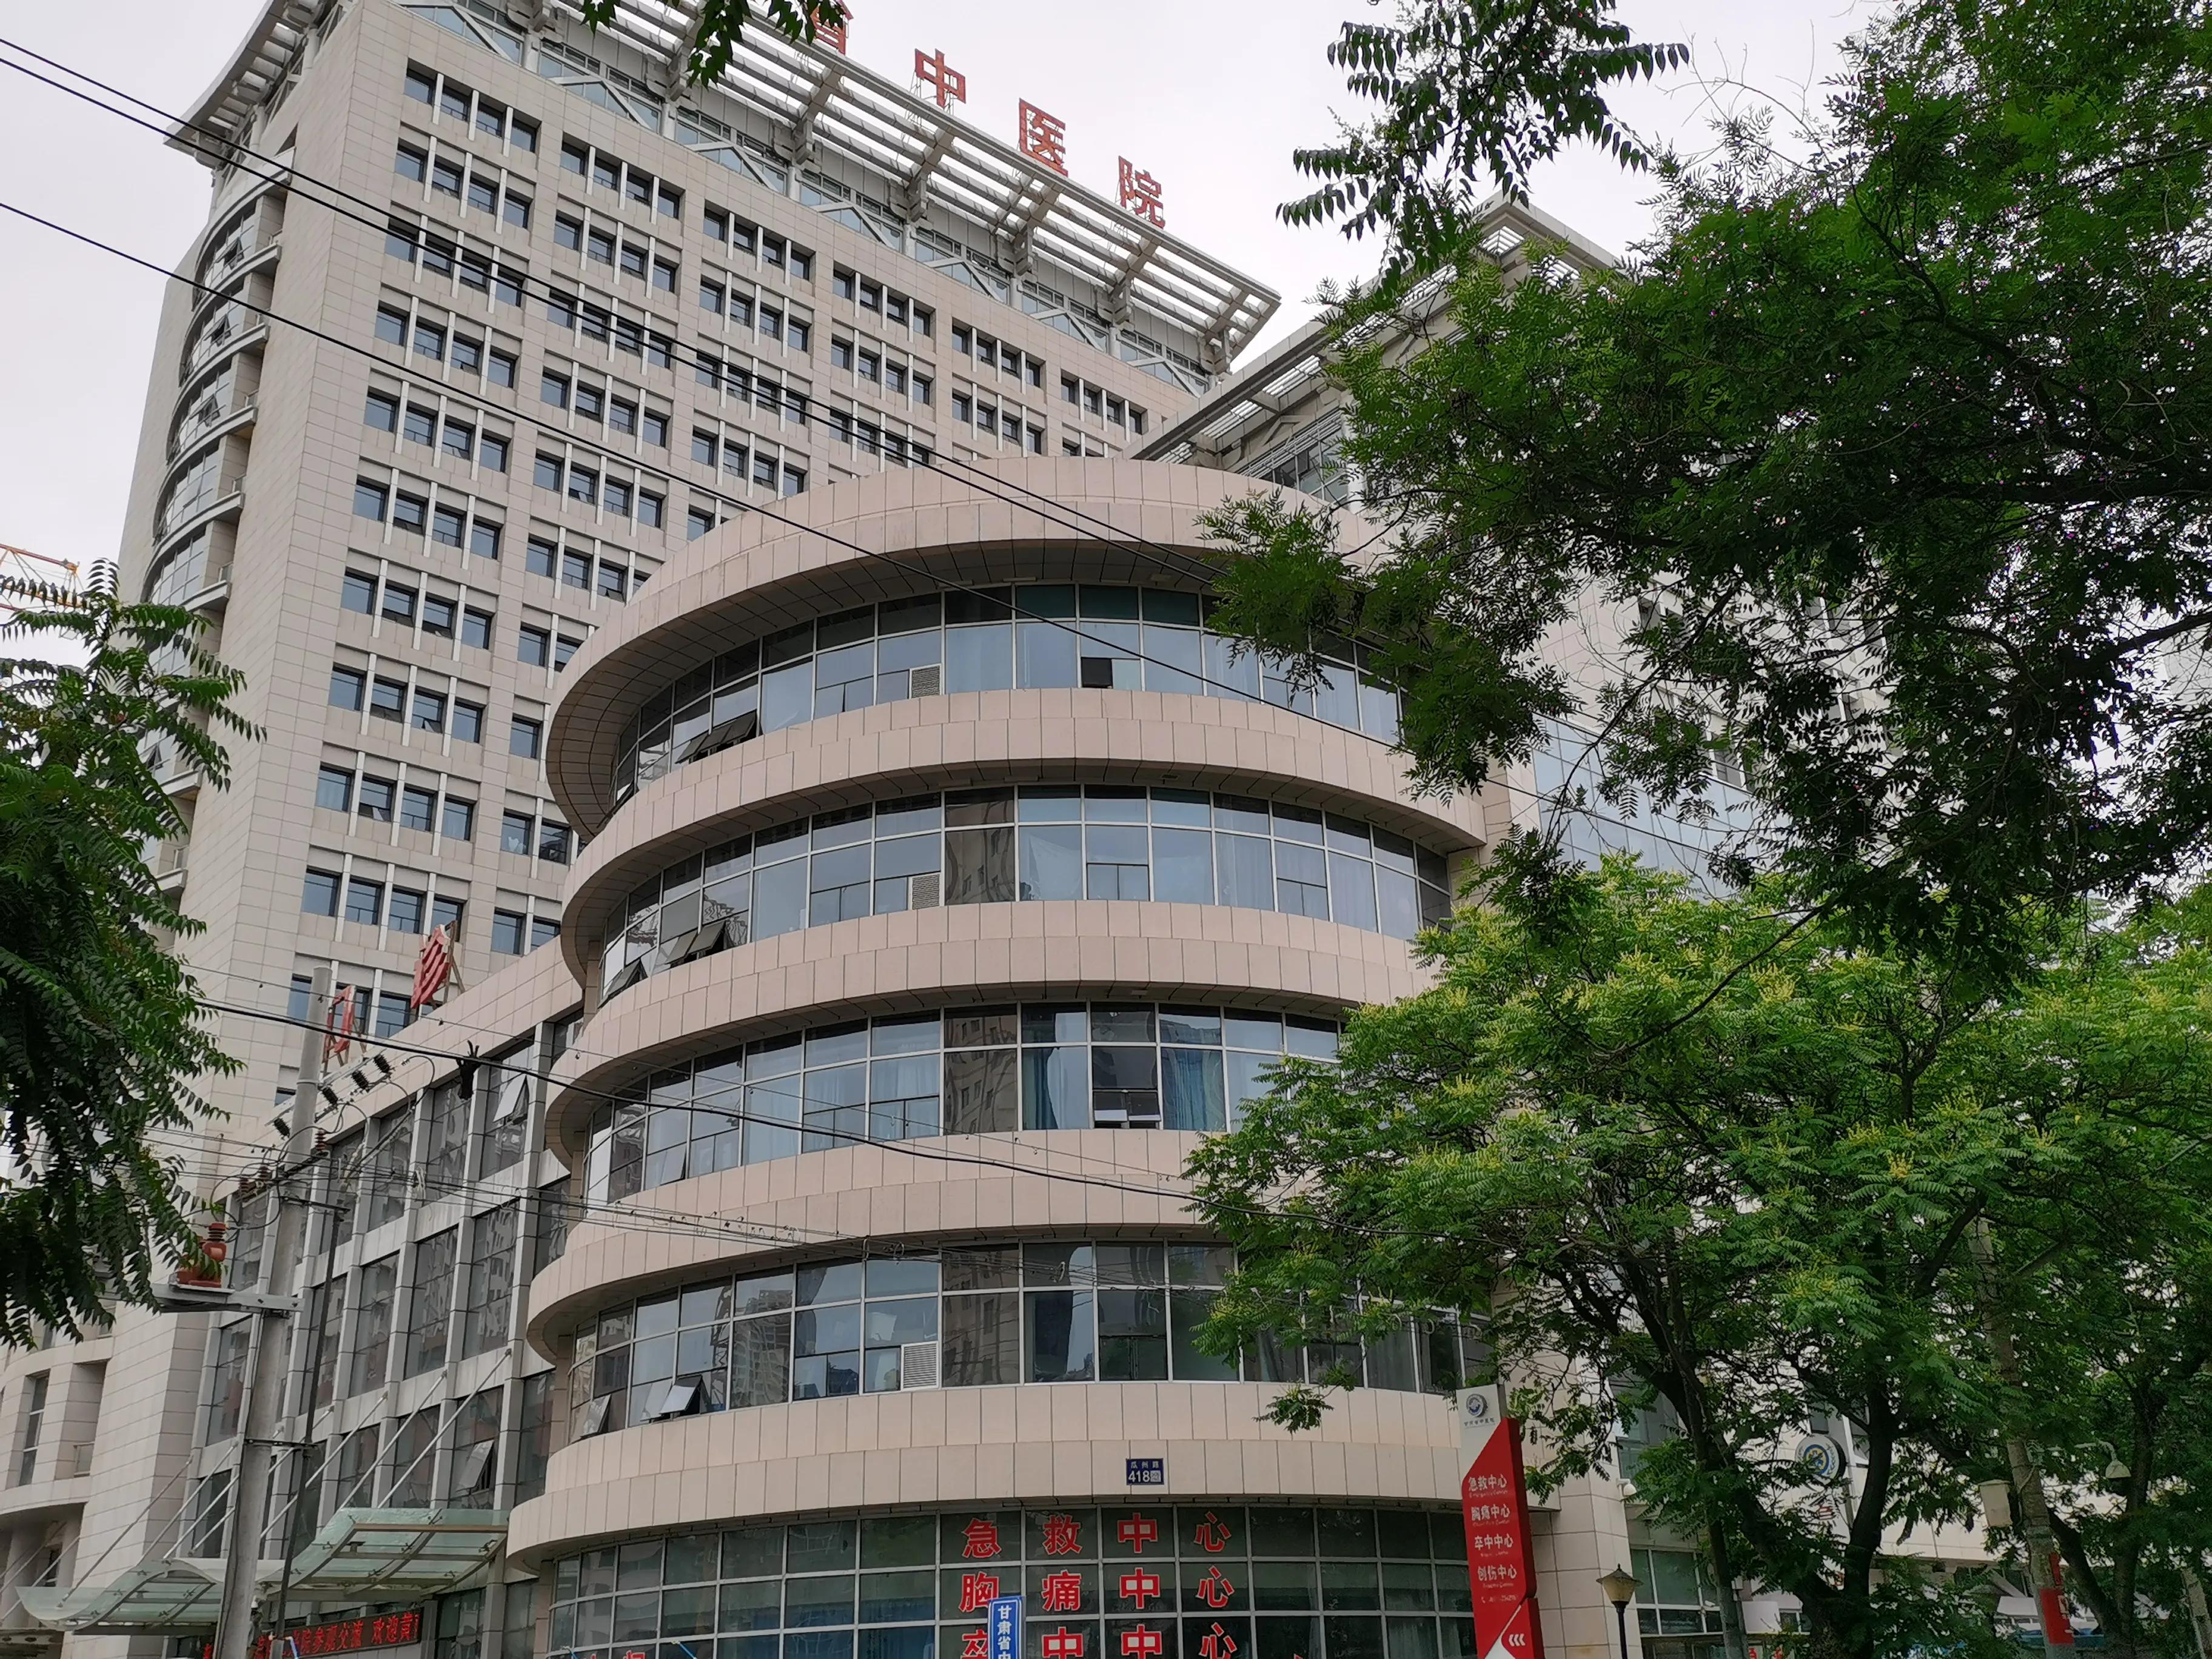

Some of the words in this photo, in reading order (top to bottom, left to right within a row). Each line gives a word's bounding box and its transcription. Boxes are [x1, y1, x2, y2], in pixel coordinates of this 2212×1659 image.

[1128, 1470, 1150, 1483] 418
[1468, 1473, 1508, 1492] 急救中心
[961, 1511, 1232, 1560] 急救中心
[1474, 1532, 1514, 1550] 卒中中心
[1477, 1564, 1517, 1581] 创伤中心
[958, 1565, 1235, 1614] 胸痛中心
